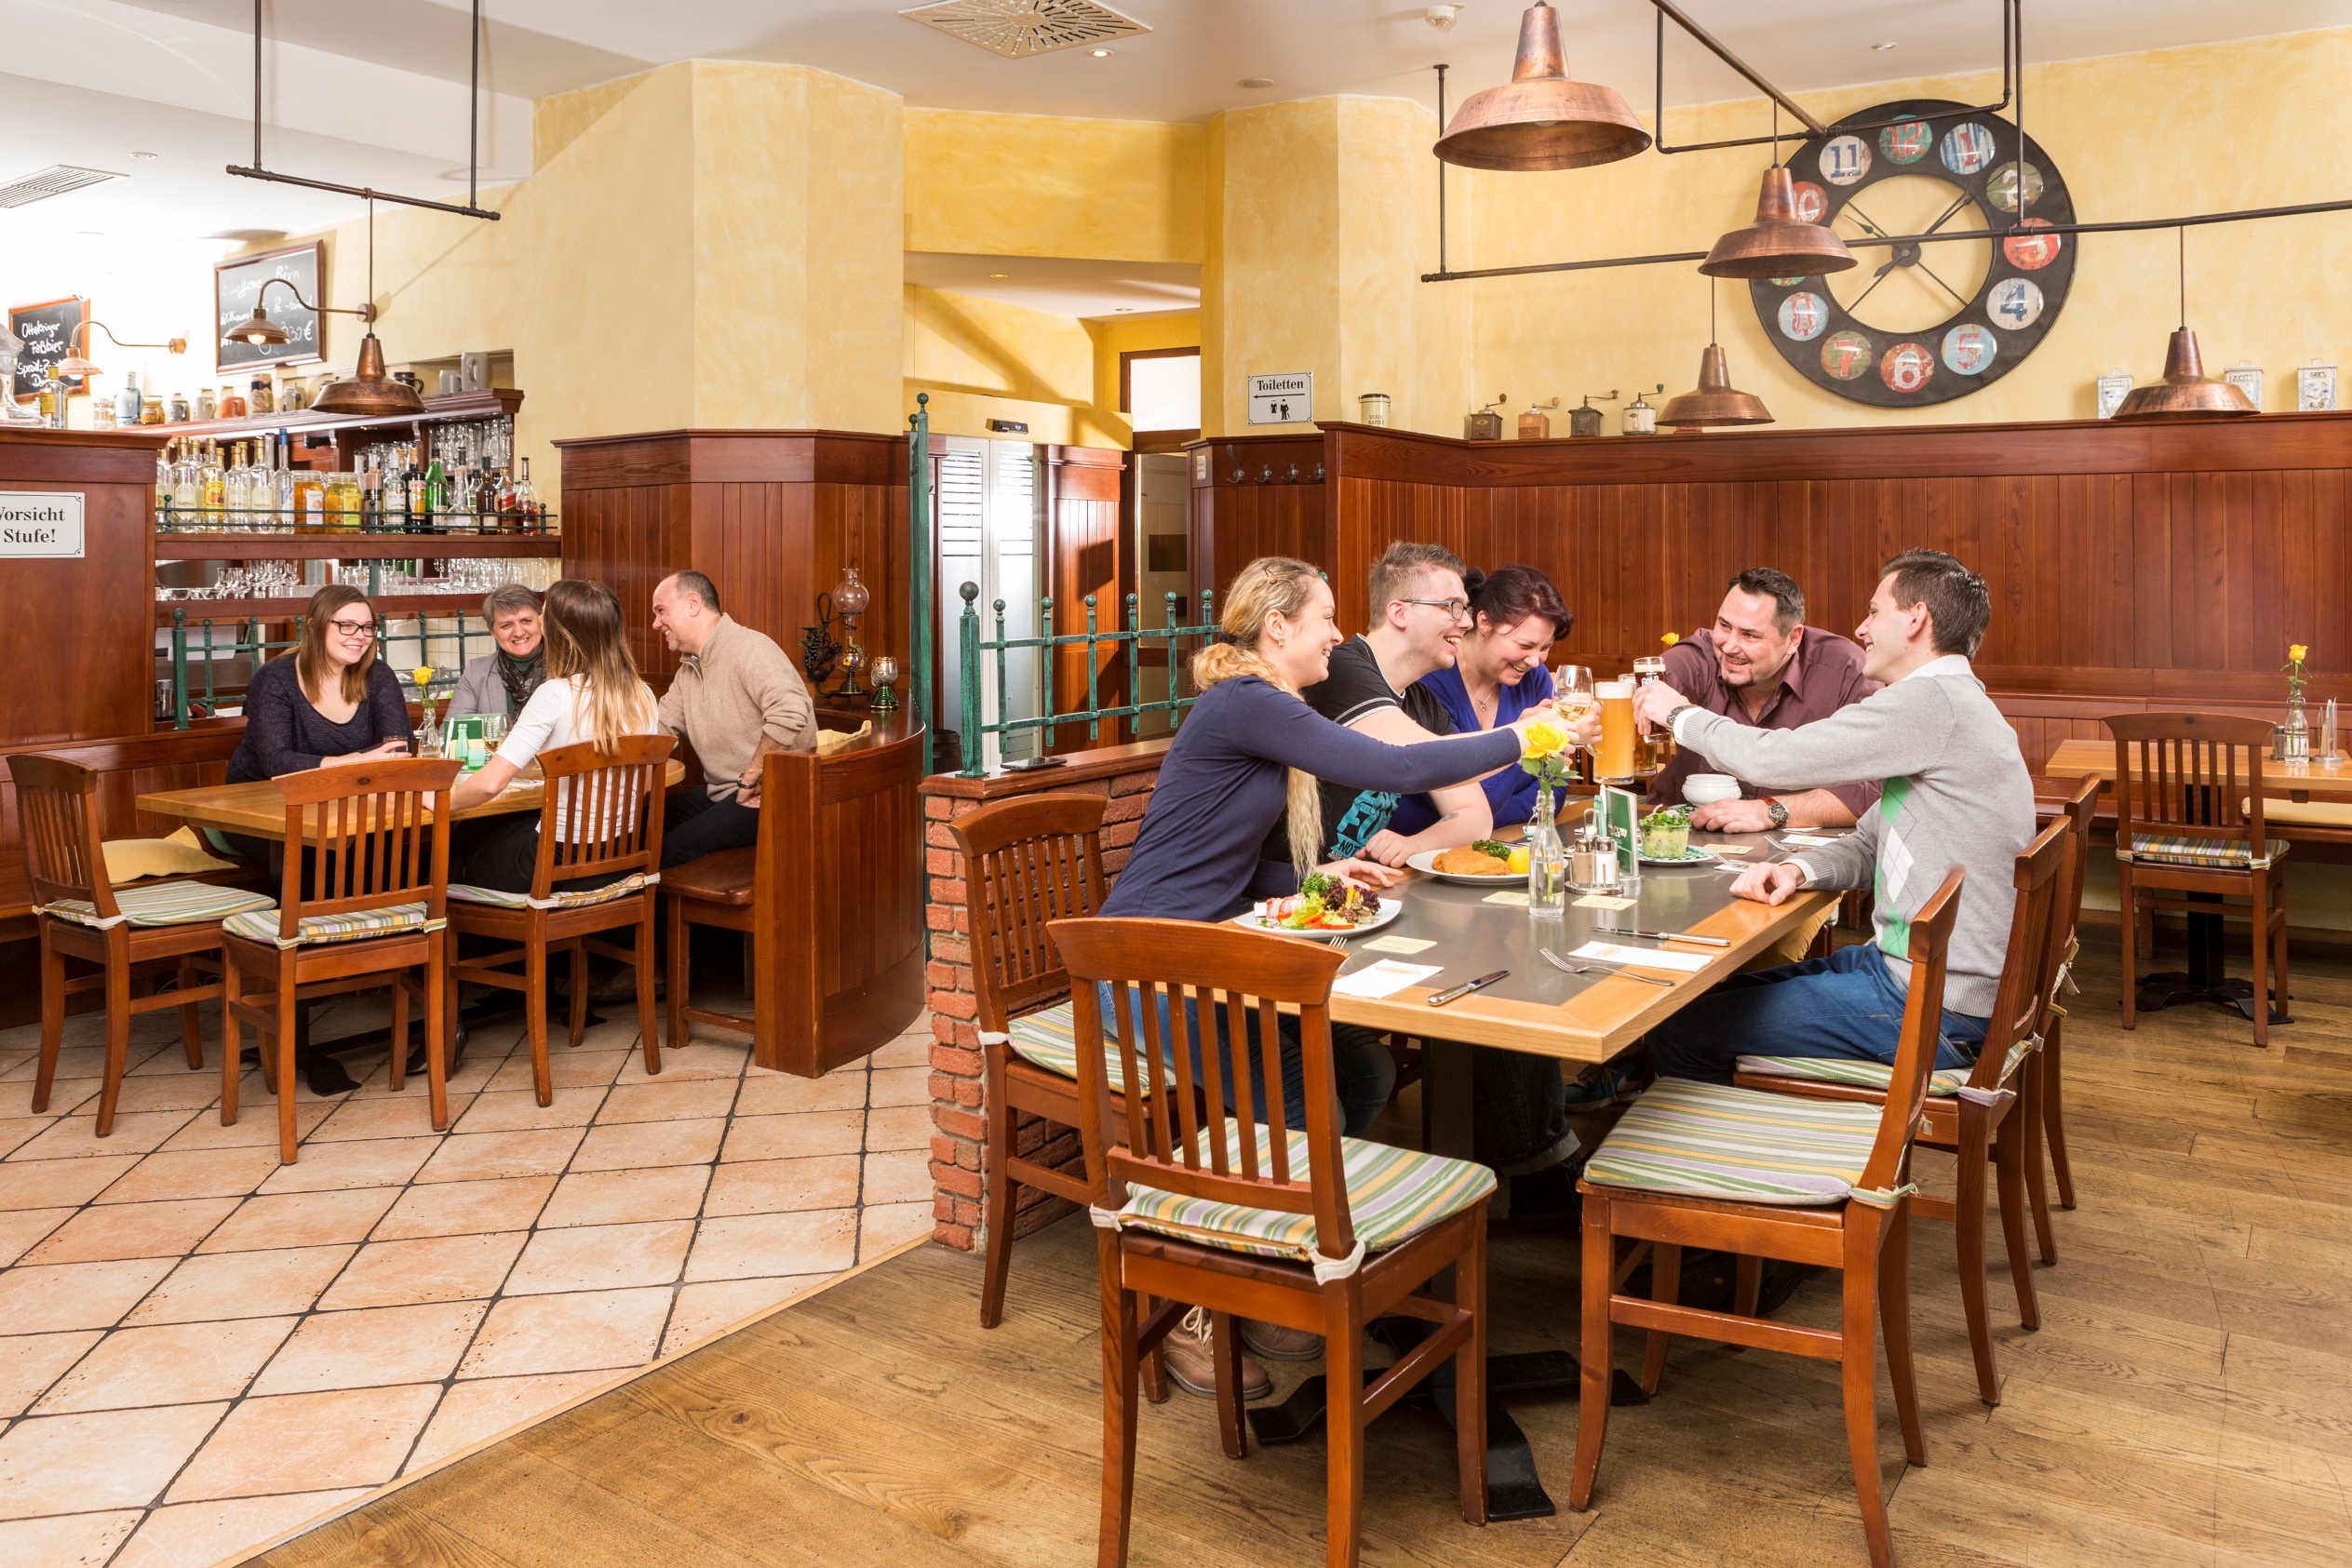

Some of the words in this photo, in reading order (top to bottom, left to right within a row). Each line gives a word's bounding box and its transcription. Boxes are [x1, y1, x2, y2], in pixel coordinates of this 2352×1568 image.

[1887, 121, 1925, 158] 12
[1959, 131, 1980, 167] 1
[1830, 143, 1861, 179] 11
[1792, 295, 1817, 337] 8
[2000, 283, 2027, 322] 4
[1834, 338, 1860, 377] 7
[1956, 332, 1982, 370] 5
[1257, 379, 1304, 391] Toiletten
[1893, 351, 1921, 389] 6
[4, 529, 56, 543] Stufe!
